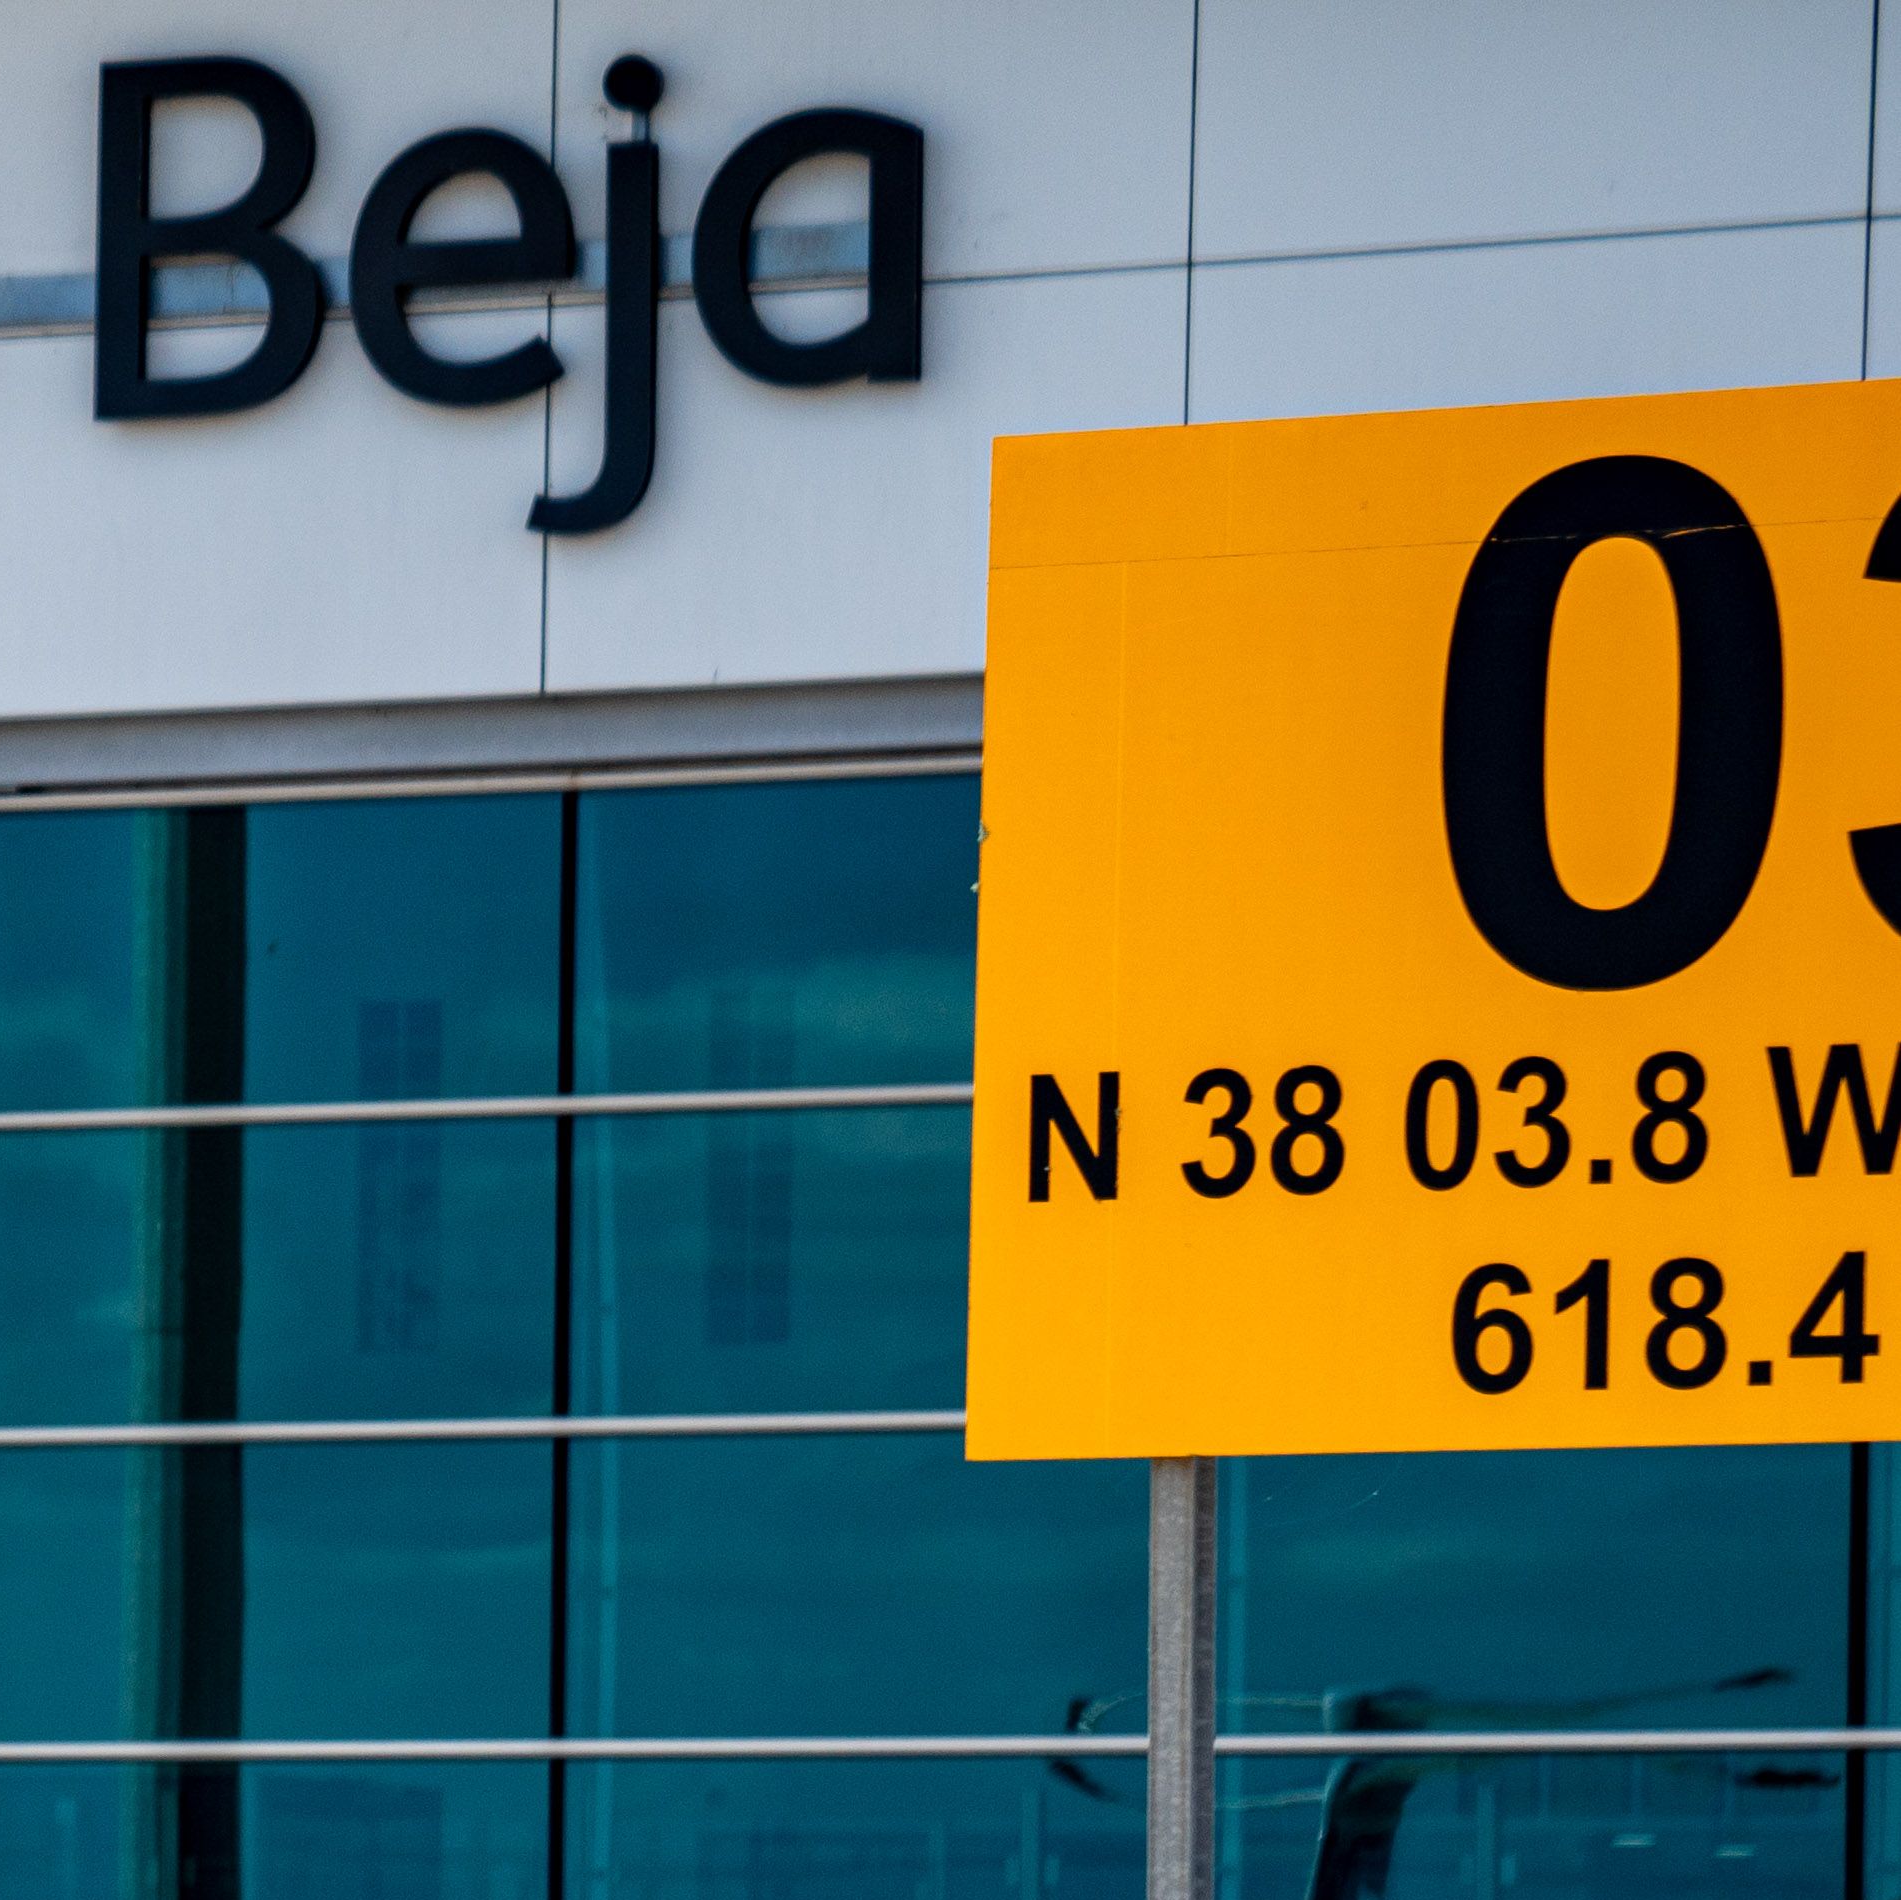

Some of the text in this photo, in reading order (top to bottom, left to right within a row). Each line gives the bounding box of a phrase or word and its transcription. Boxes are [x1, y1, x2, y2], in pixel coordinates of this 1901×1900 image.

[93, 52, 929, 536] Beja
[1441, 455, 1901, 991] 0
[1028, 1071, 1120, 1203] N
[1181, 1065, 1345, 1199] 38
[1405, 1051, 1709, 1192] 03.8
[1452, 1250, 1880, 1395] 618.4
